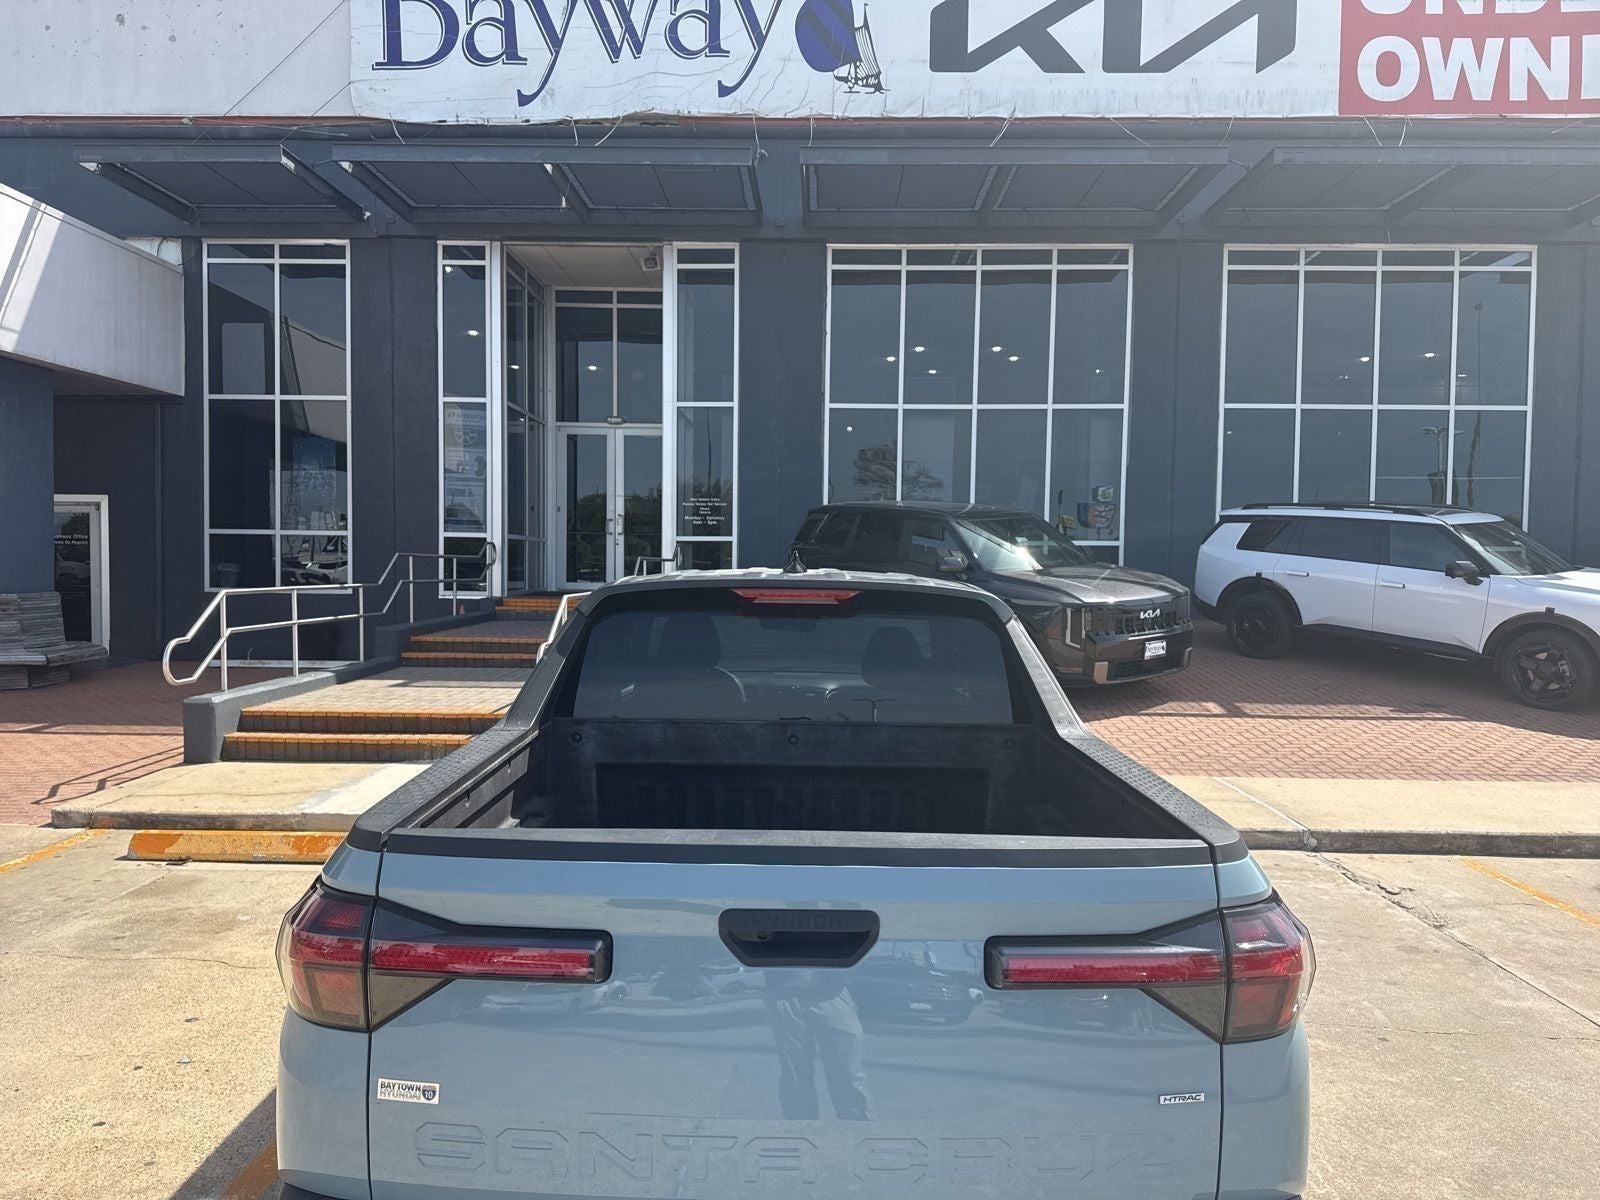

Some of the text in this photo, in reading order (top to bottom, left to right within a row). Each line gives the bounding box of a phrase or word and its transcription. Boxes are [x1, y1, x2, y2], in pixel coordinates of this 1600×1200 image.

[380, 1081, 421, 1092] BAYTOWN
[424, 1090, 433, 1100] 10
[1163, 1094, 1202, 1103] HTRAC
[415, 1121, 819, 1185] SANTA
[854, 1132, 1175, 1188] CRUZ
